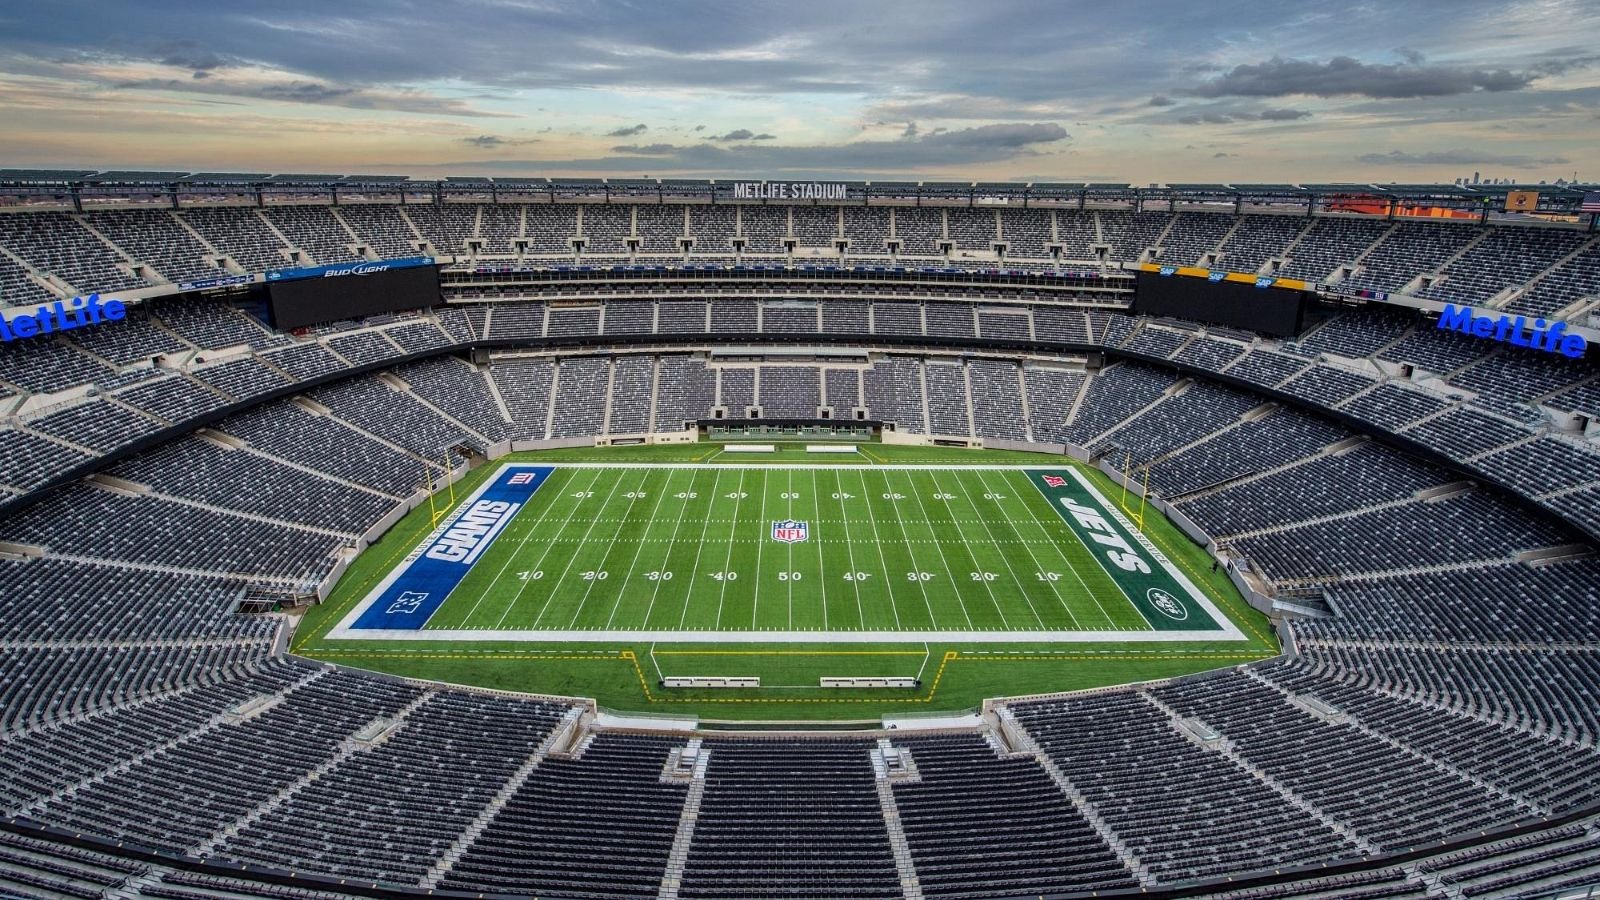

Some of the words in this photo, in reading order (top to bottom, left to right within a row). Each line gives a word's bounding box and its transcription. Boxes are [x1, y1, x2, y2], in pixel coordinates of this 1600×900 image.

[734, 183, 787, 198] METLIFE
[791, 184, 847, 199] STADIUM
[325, 269, 351, 278] BUD
[358, 265, 390, 274] LIGHT
[1160, 266, 1175, 275] SAP
[1208, 272, 1224, 281] SAP
[1256, 279, 1272, 287] SAP
[1437, 303, 1588, 358] MetLife
[577, 491, 595, 499] 10
[628, 491, 647, 499] 20
[680, 491, 698, 499] 30
[731, 491, 749, 499] 40
[780, 491, 799, 499] 50
[832, 491, 850, 499] 40
[883, 491, 902, 499] 30
[933, 491, 952, 499] 20
[984, 491, 1003, 499] 10
[426, 499, 510, 563] GIANTS
[776, 528, 805, 540] NFL
[1060, 497, 1151, 574] JETS
[518, 571, 544, 581] 10
[583, 571, 609, 581] 20
[648, 571, 673, 581] 30
[713, 571, 738, 581] 40
[778, 571, 802, 581] 50
[843, 571, 867, 581] 40
[907, 571, 931, 581] 30
[970, 571, 994, 581] 20
[1034, 571, 1058, 581] 10
